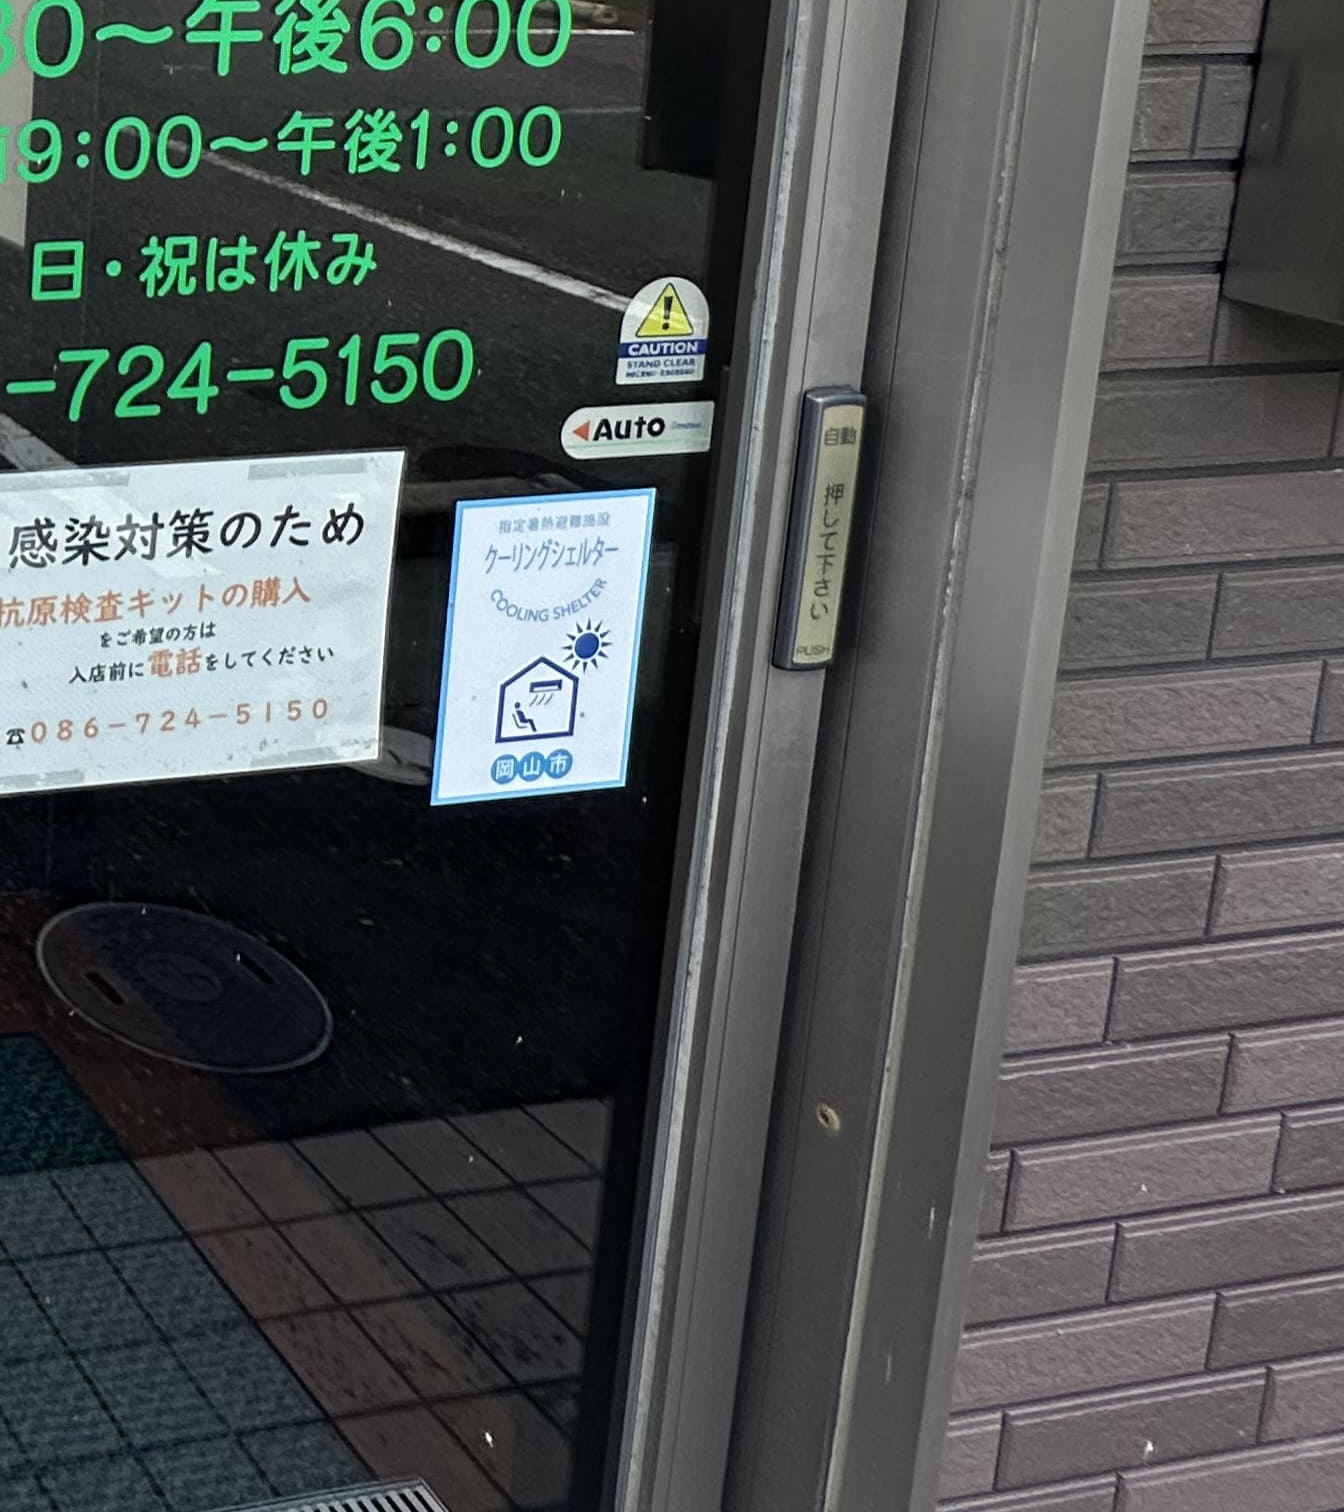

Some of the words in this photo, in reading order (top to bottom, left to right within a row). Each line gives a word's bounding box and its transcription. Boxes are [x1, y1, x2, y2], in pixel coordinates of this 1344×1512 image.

[628, 342, 698, 356] CAUTION
[593, 416, 665, 441] Auto
[9, 503, 365, 573] 感染対策のため
[485, 537, 619, 574] クーリングシェルター
[490, 589, 549, 622] COOLING
[553, 577, 607, 619] SHELTER
[99, 622, 217, 649] をご希望の方は
[68, 646, 335, 684] 入店前に電話をしてください
[495, 754, 569, 779] 岡山市
